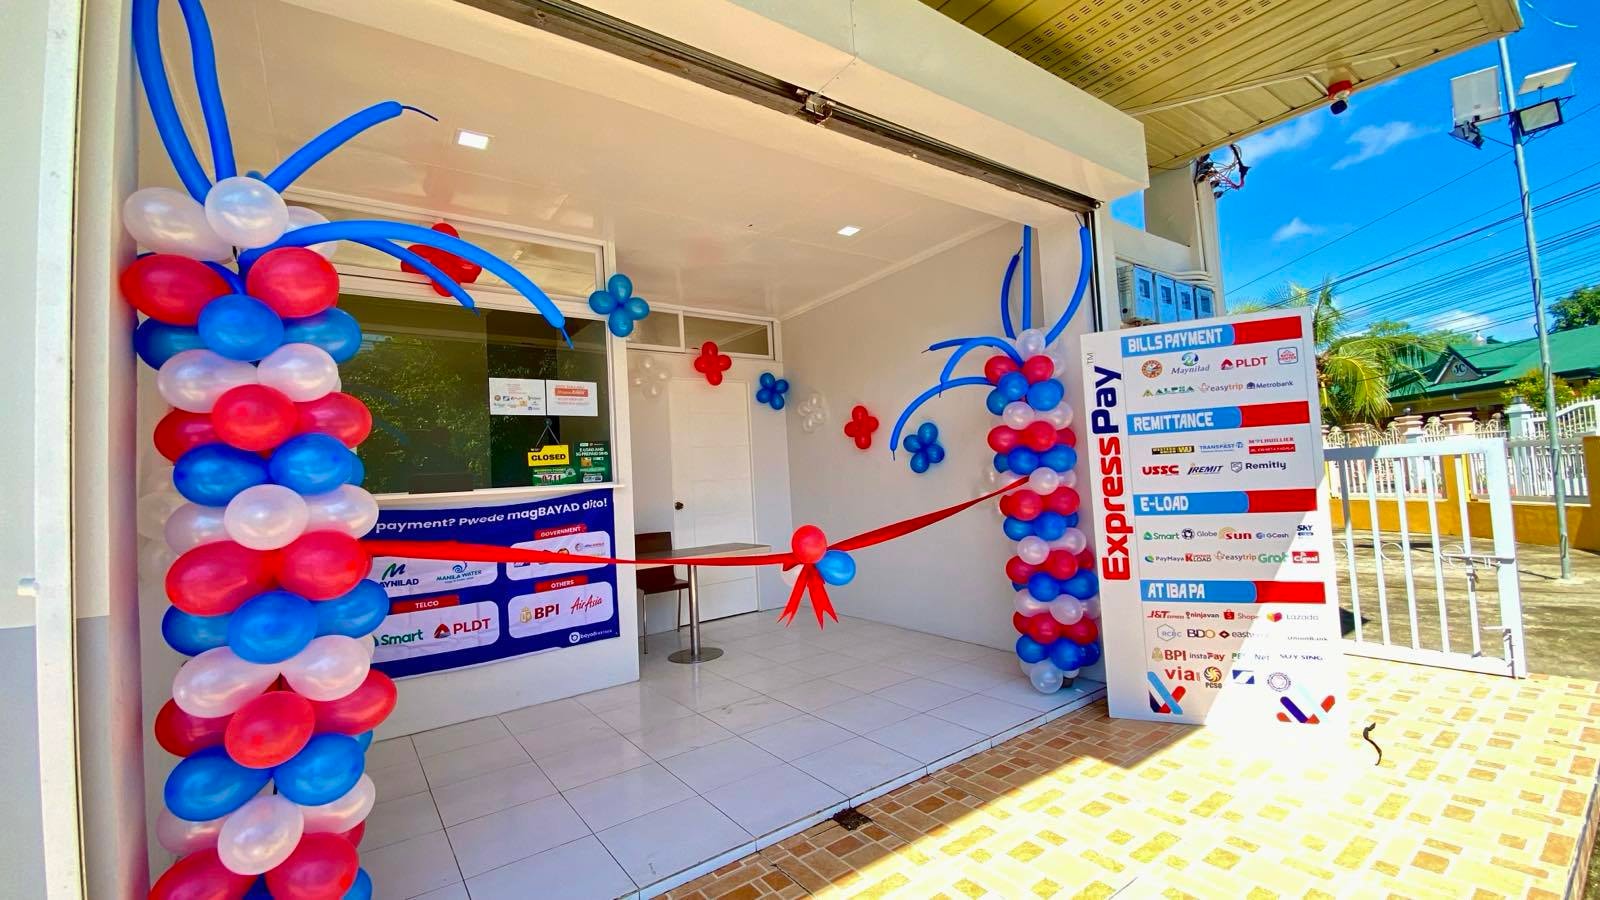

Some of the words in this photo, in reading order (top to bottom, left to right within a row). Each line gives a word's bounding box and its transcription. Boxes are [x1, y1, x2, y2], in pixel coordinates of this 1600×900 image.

[1128, 332, 1163, 353] BILLS
[1164, 328, 1223, 349] PAYMENT
[1086, 352, 1094, 365] TM
[1236, 356, 1268, 368] PLDT
[1171, 364, 1210, 375] Maynilad
[1210, 383, 1244, 392] easytrip
[1256, 380, 1294, 389] Metrobank
[1133, 411, 1214, 431] REMITTANCE
[531, 453, 566, 461] CLOSED
[1142, 465, 1180, 475] USSC
[1245, 460, 1287, 471] Remitly
[1091, 365, 1133, 581] ExpressPay
[1140, 496, 1189, 512] E-LOAD
[376, 518, 456, 533] payment?
[459, 515, 504, 526] Pwede
[507, 503, 580, 522] magBAYAD
[582, 497, 608, 511] dito!
[540, 527, 581, 537] GOVERNMENT
[1153, 532, 1180, 540] Smart
[1225, 532, 1252, 540] sun
[1225, 554, 1256, 562] easytrip
[436, 574, 461, 582] MANILA
[462, 569, 482, 578] WATER
[379, 578, 420, 589] AYNILAD
[550, 578, 575, 589] OTHERS
[1147, 583, 1164, 598] AT
[1166, 583, 1189, 598] IBA
[1189, 583, 1205, 599] PA
[415, 599, 439, 609] TELCO
[570, 596, 603, 614] AirAsia
[534, 603, 560, 620] BPI
[1147, 610, 1169, 619] J&T
[1190, 611, 1220, 620] ninjavan
[1286, 613, 1319, 621] Lazada
[453, 618, 491, 635] PLDT
[380, 629, 423, 646] Smart
[1187, 629, 1216, 638] BDO
[1164, 649, 1187, 661] BPI
[1189, 652, 1225, 662] instaPay
[1164, 666, 1195, 681] via
